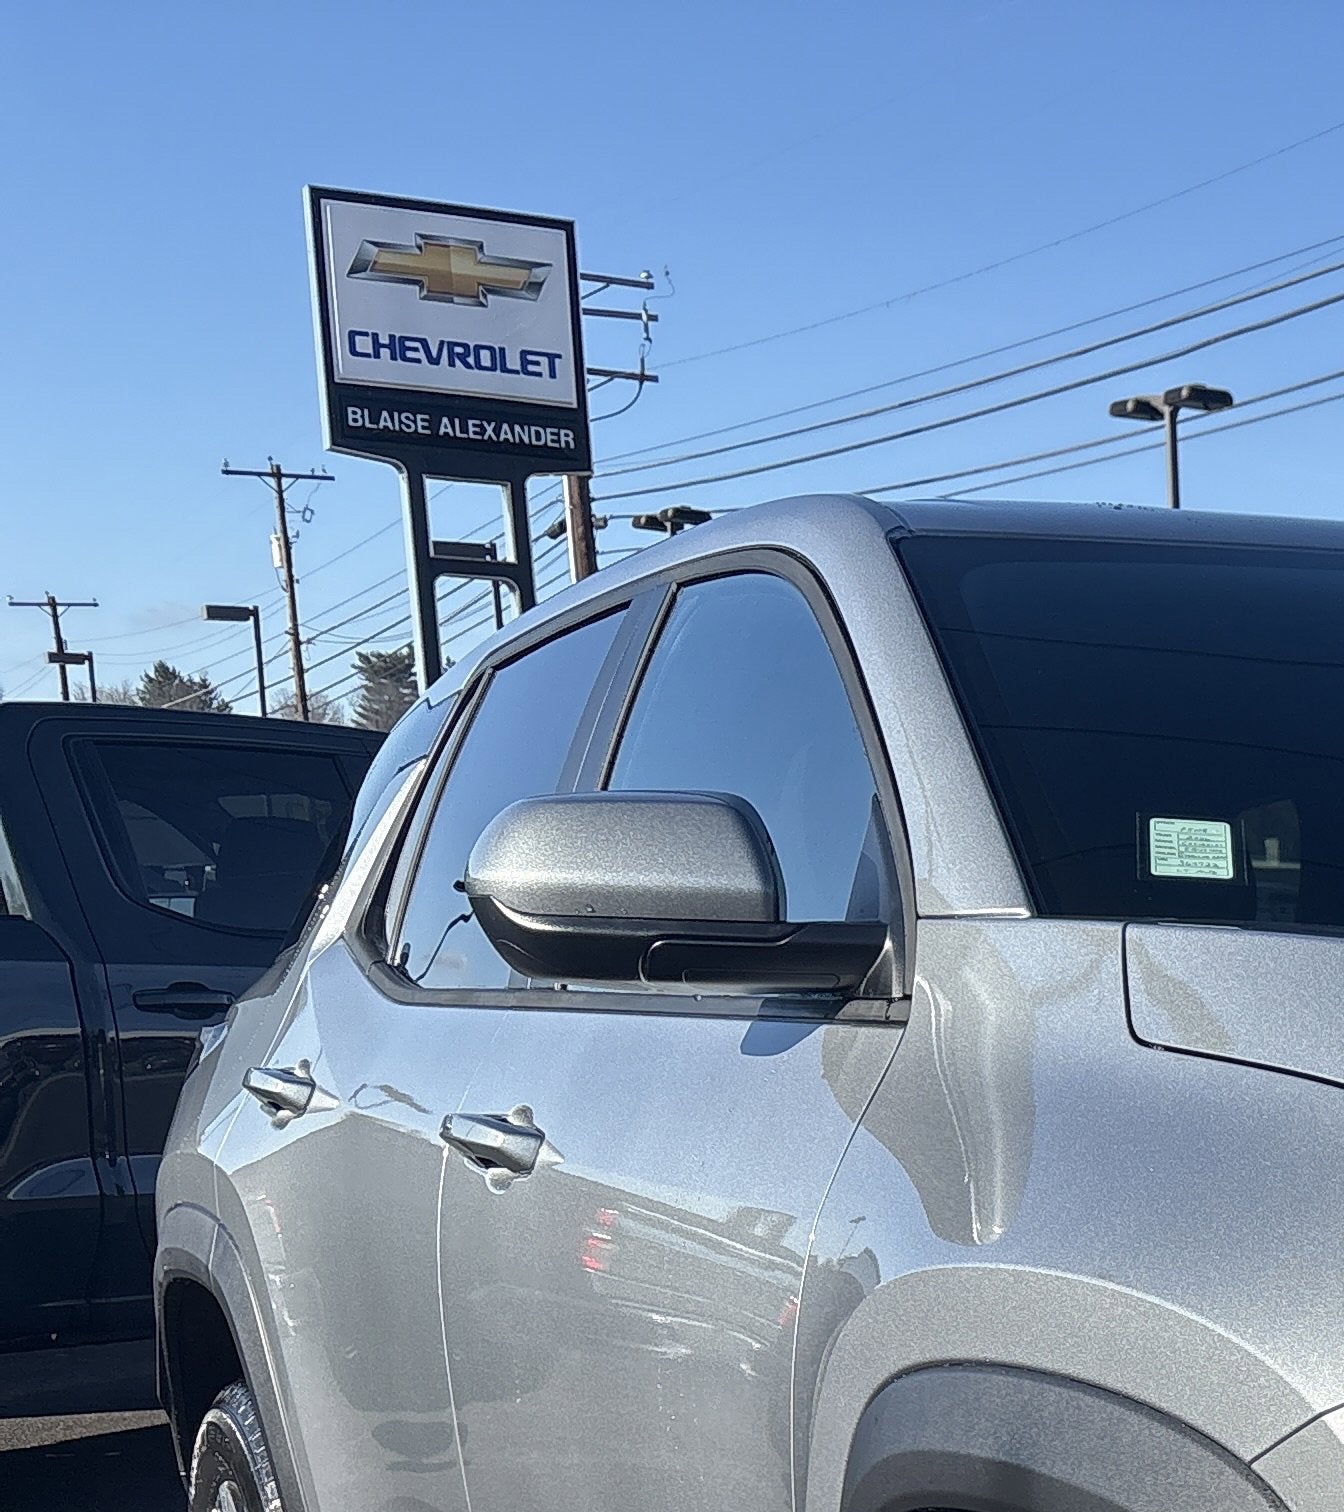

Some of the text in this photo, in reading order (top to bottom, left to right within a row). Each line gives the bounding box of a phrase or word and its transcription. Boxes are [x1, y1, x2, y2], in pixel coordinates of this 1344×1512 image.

[347, 329, 563, 379] CHEVROLET
[346, 405, 575, 450] BLAISE ALEXANDER
